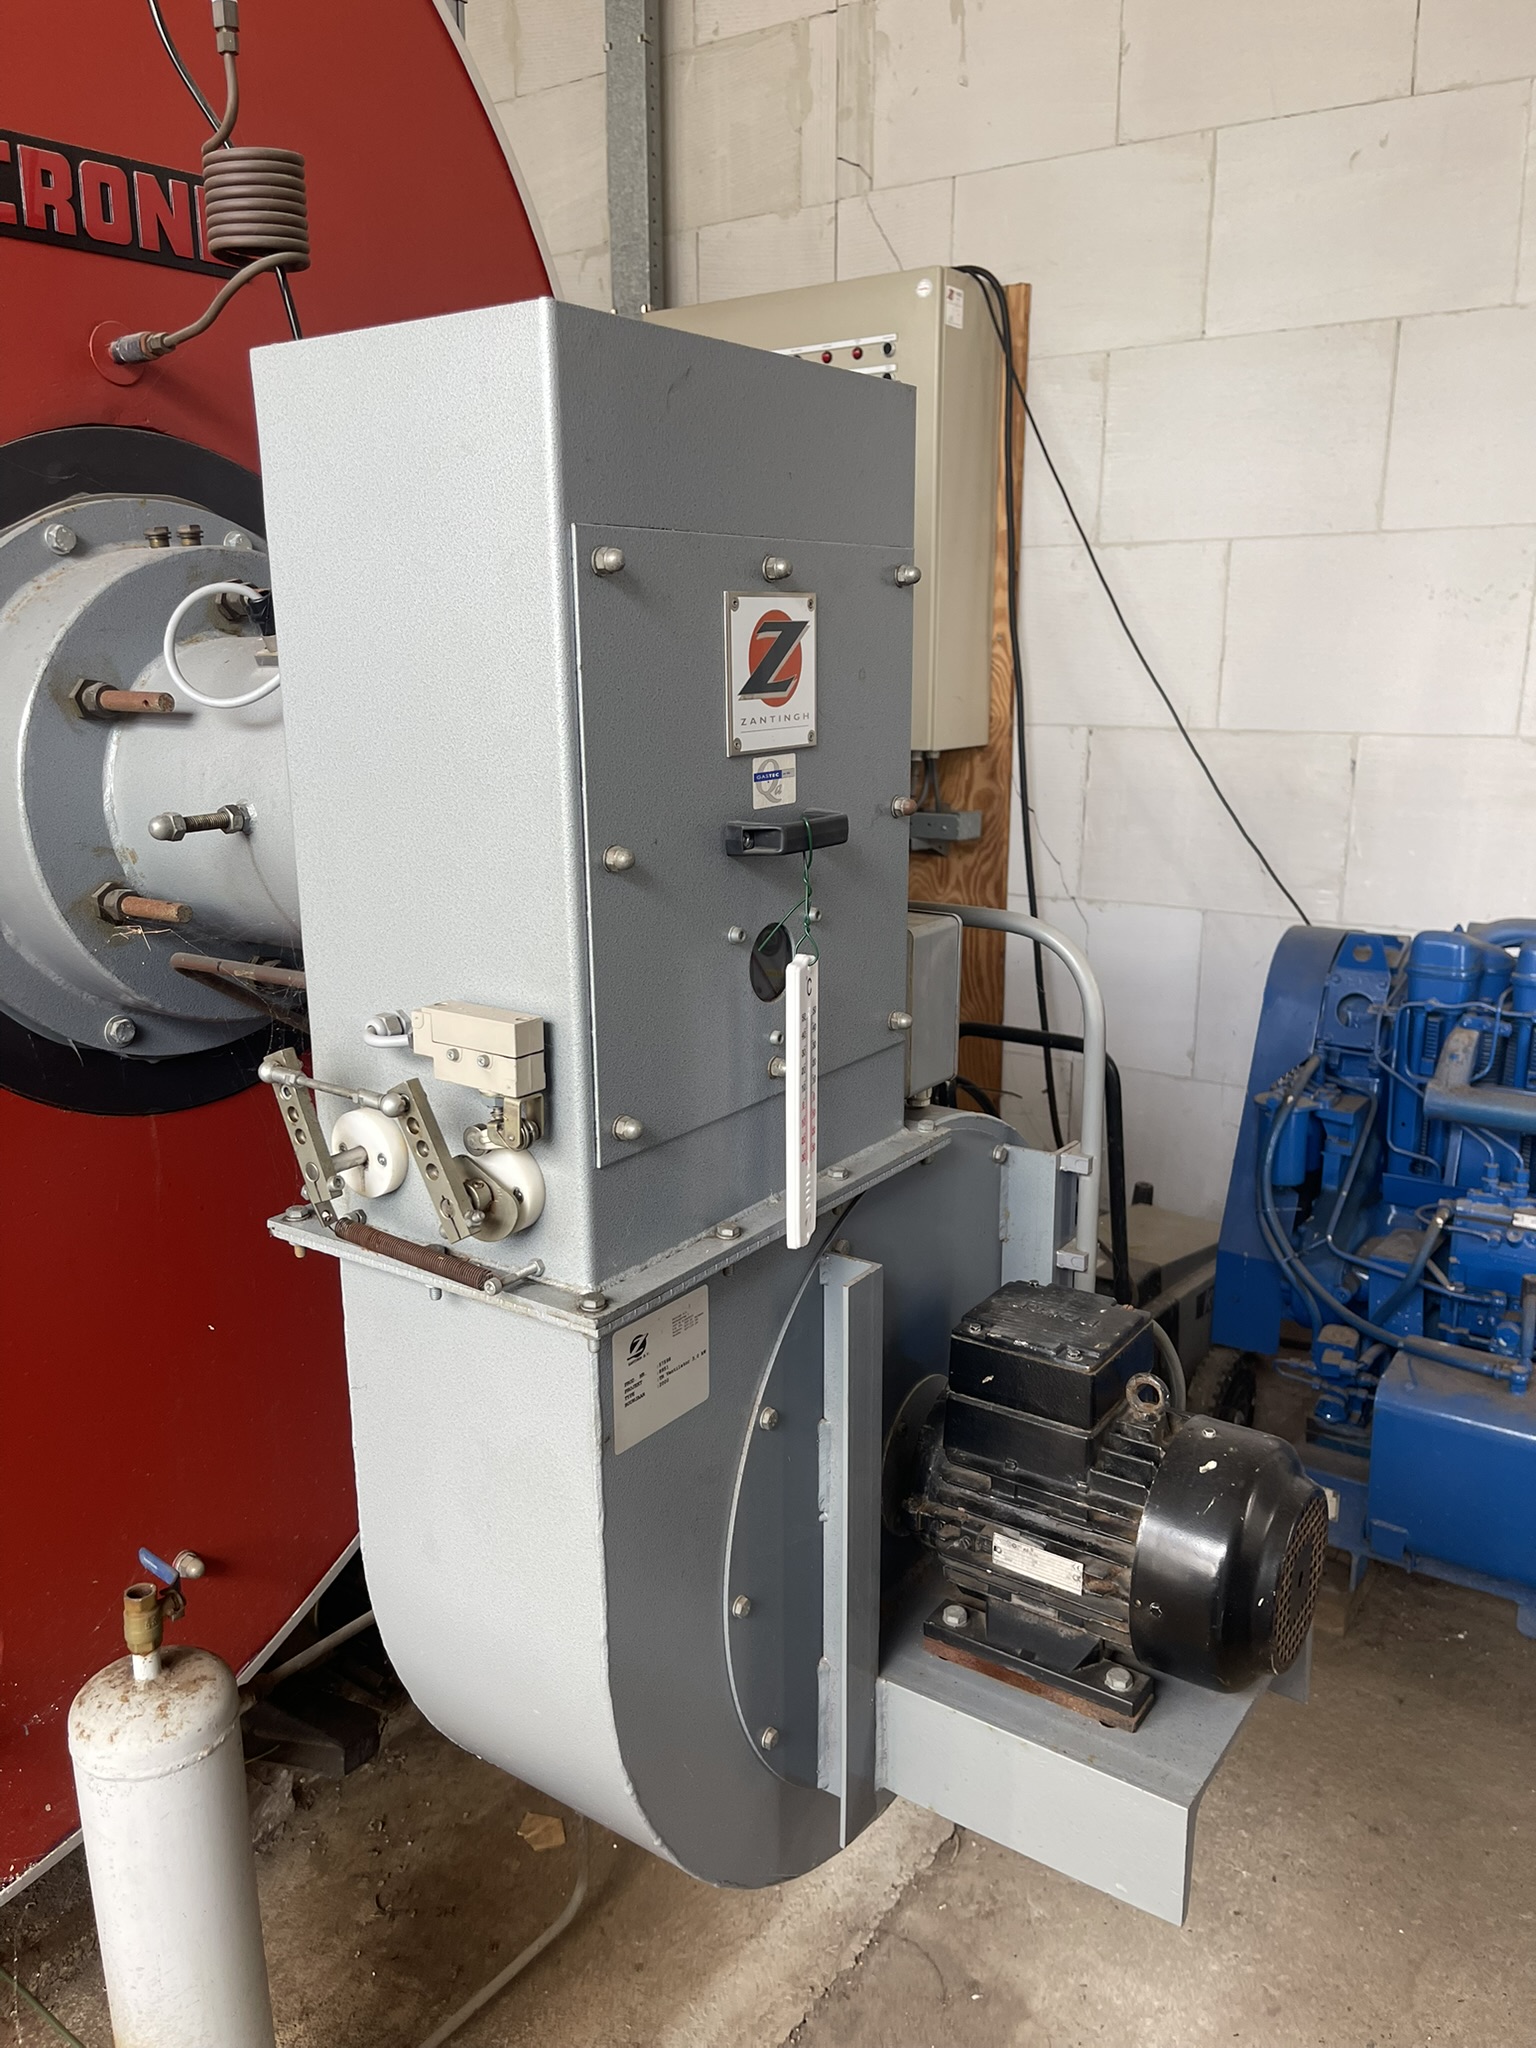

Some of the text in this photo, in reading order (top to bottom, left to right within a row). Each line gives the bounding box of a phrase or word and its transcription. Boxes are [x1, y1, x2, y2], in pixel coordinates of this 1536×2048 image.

[738, 620, 810, 700] Z
[740, 712, 810, 726] ZANTINGH
[756, 772, 780, 780] GASTEC
